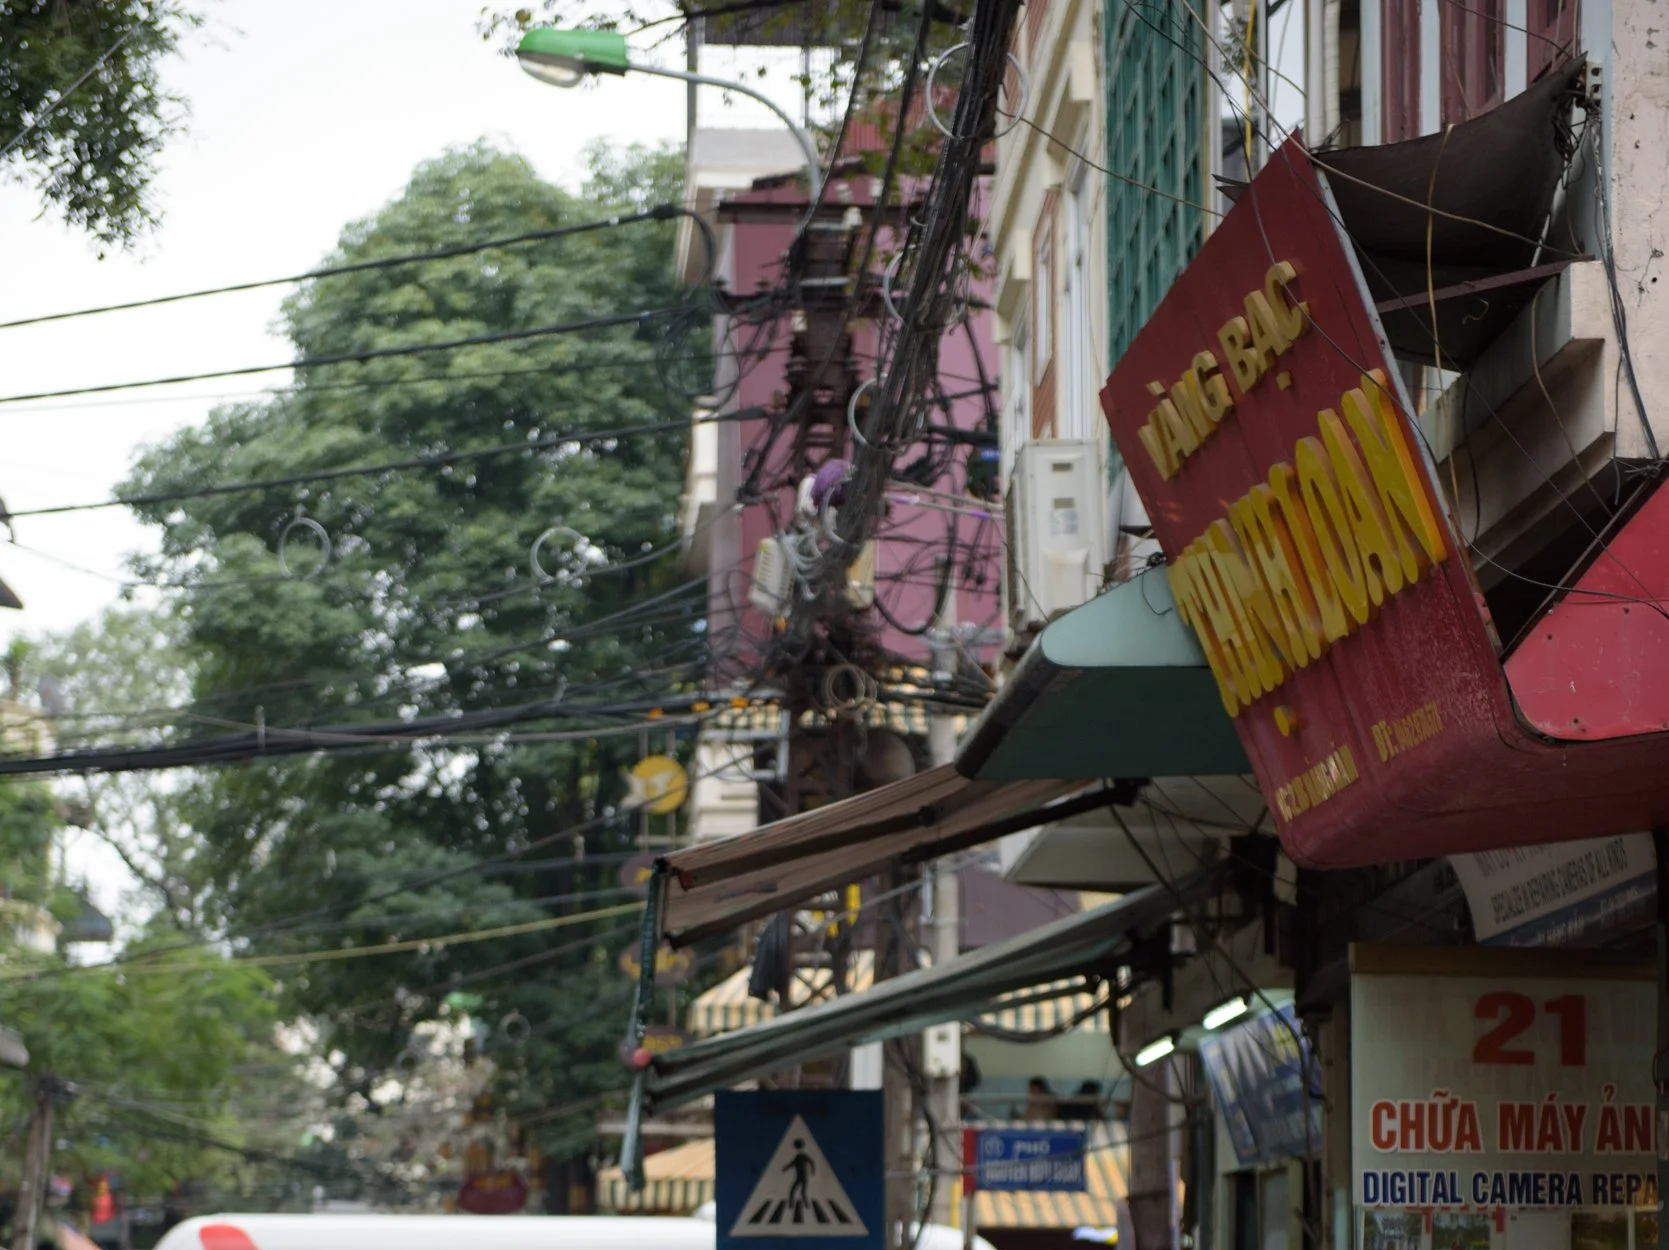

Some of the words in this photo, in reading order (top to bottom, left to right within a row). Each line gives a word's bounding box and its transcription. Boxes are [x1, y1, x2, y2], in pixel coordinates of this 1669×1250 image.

[1137, 350, 1234, 481] VÀNG
[1216, 259, 1312, 394] BẠC
[1167, 483, 1323, 737] THỊNH
[1268, 368, 1447, 647] LOAN
[1473, 990, 1586, 1066] 21
[1371, 1090, 1482, 1150] CHỮA
[1500, 1091, 1587, 1150] MÁY
[1597, 1085, 1658, 1151] ẢN
[1363, 1172, 1463, 1205] DIGITAL
[1473, 1173, 1583, 1205] CAMERA
